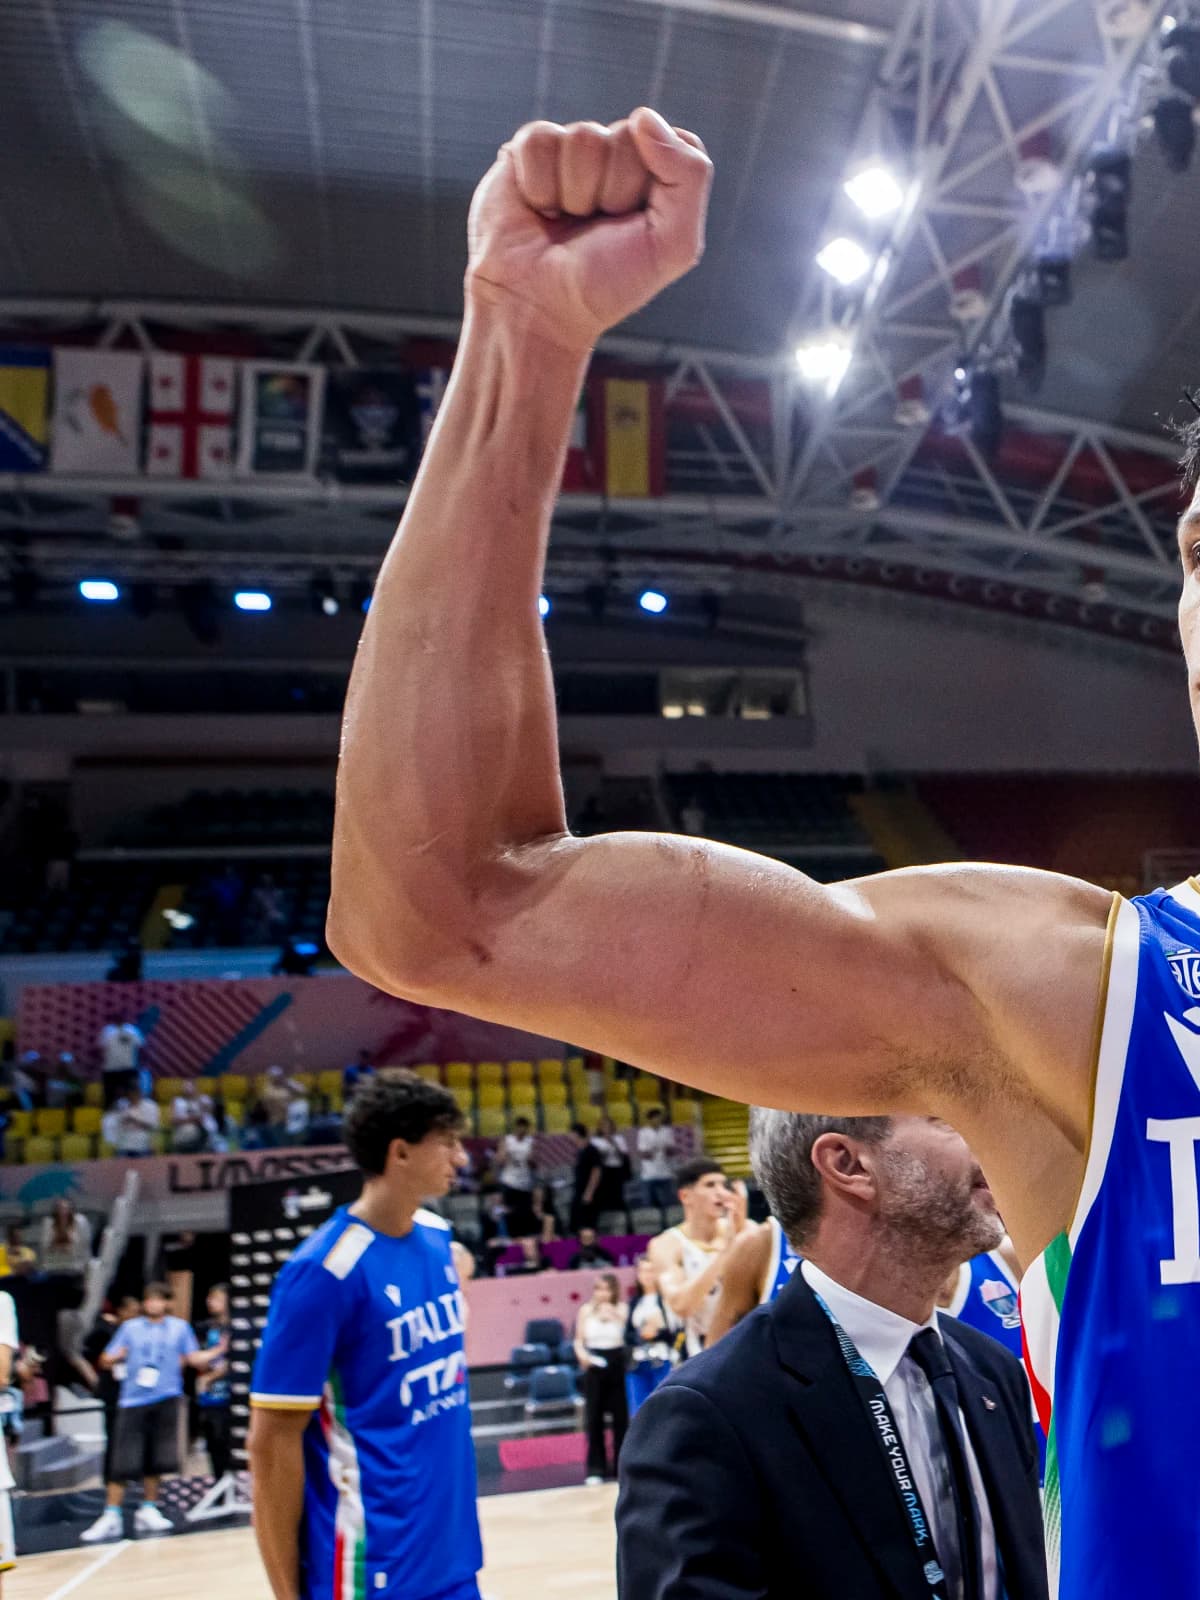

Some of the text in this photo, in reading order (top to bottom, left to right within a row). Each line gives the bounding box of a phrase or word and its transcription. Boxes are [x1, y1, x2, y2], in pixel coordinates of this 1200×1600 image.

[869, 1400, 929, 1542] MAKE YOUR MARK
